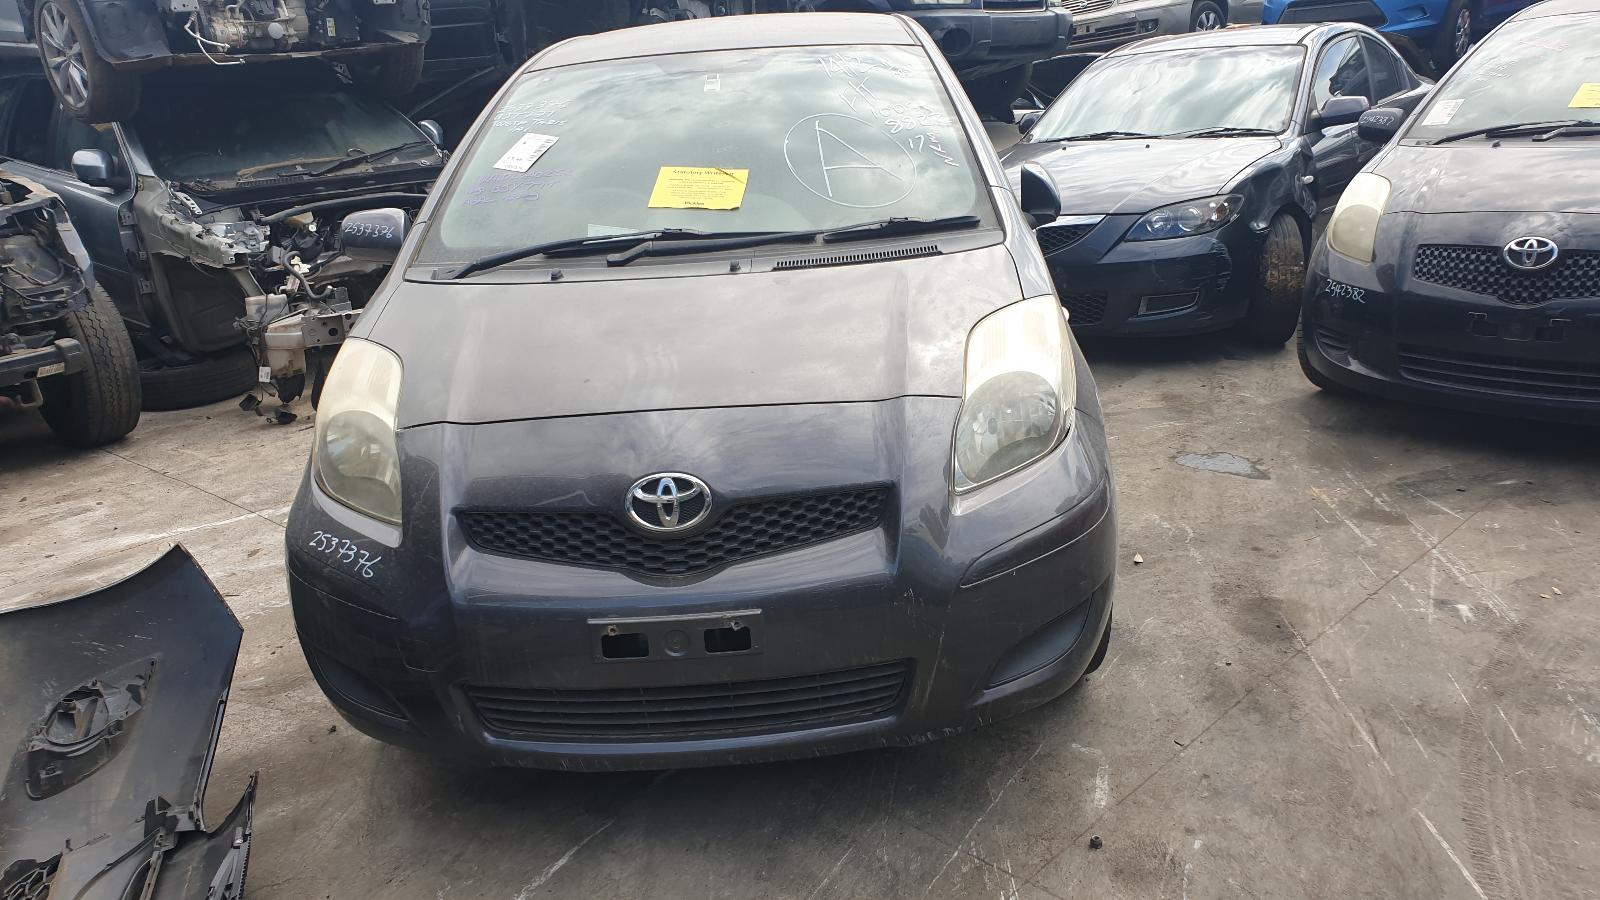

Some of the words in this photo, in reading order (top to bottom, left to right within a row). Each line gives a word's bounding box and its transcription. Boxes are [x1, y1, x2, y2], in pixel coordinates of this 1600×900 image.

[344, 222, 396, 239] 2537376
[1325, 278, 1366, 304] 2542382
[308, 530, 382, 578] 2537376
